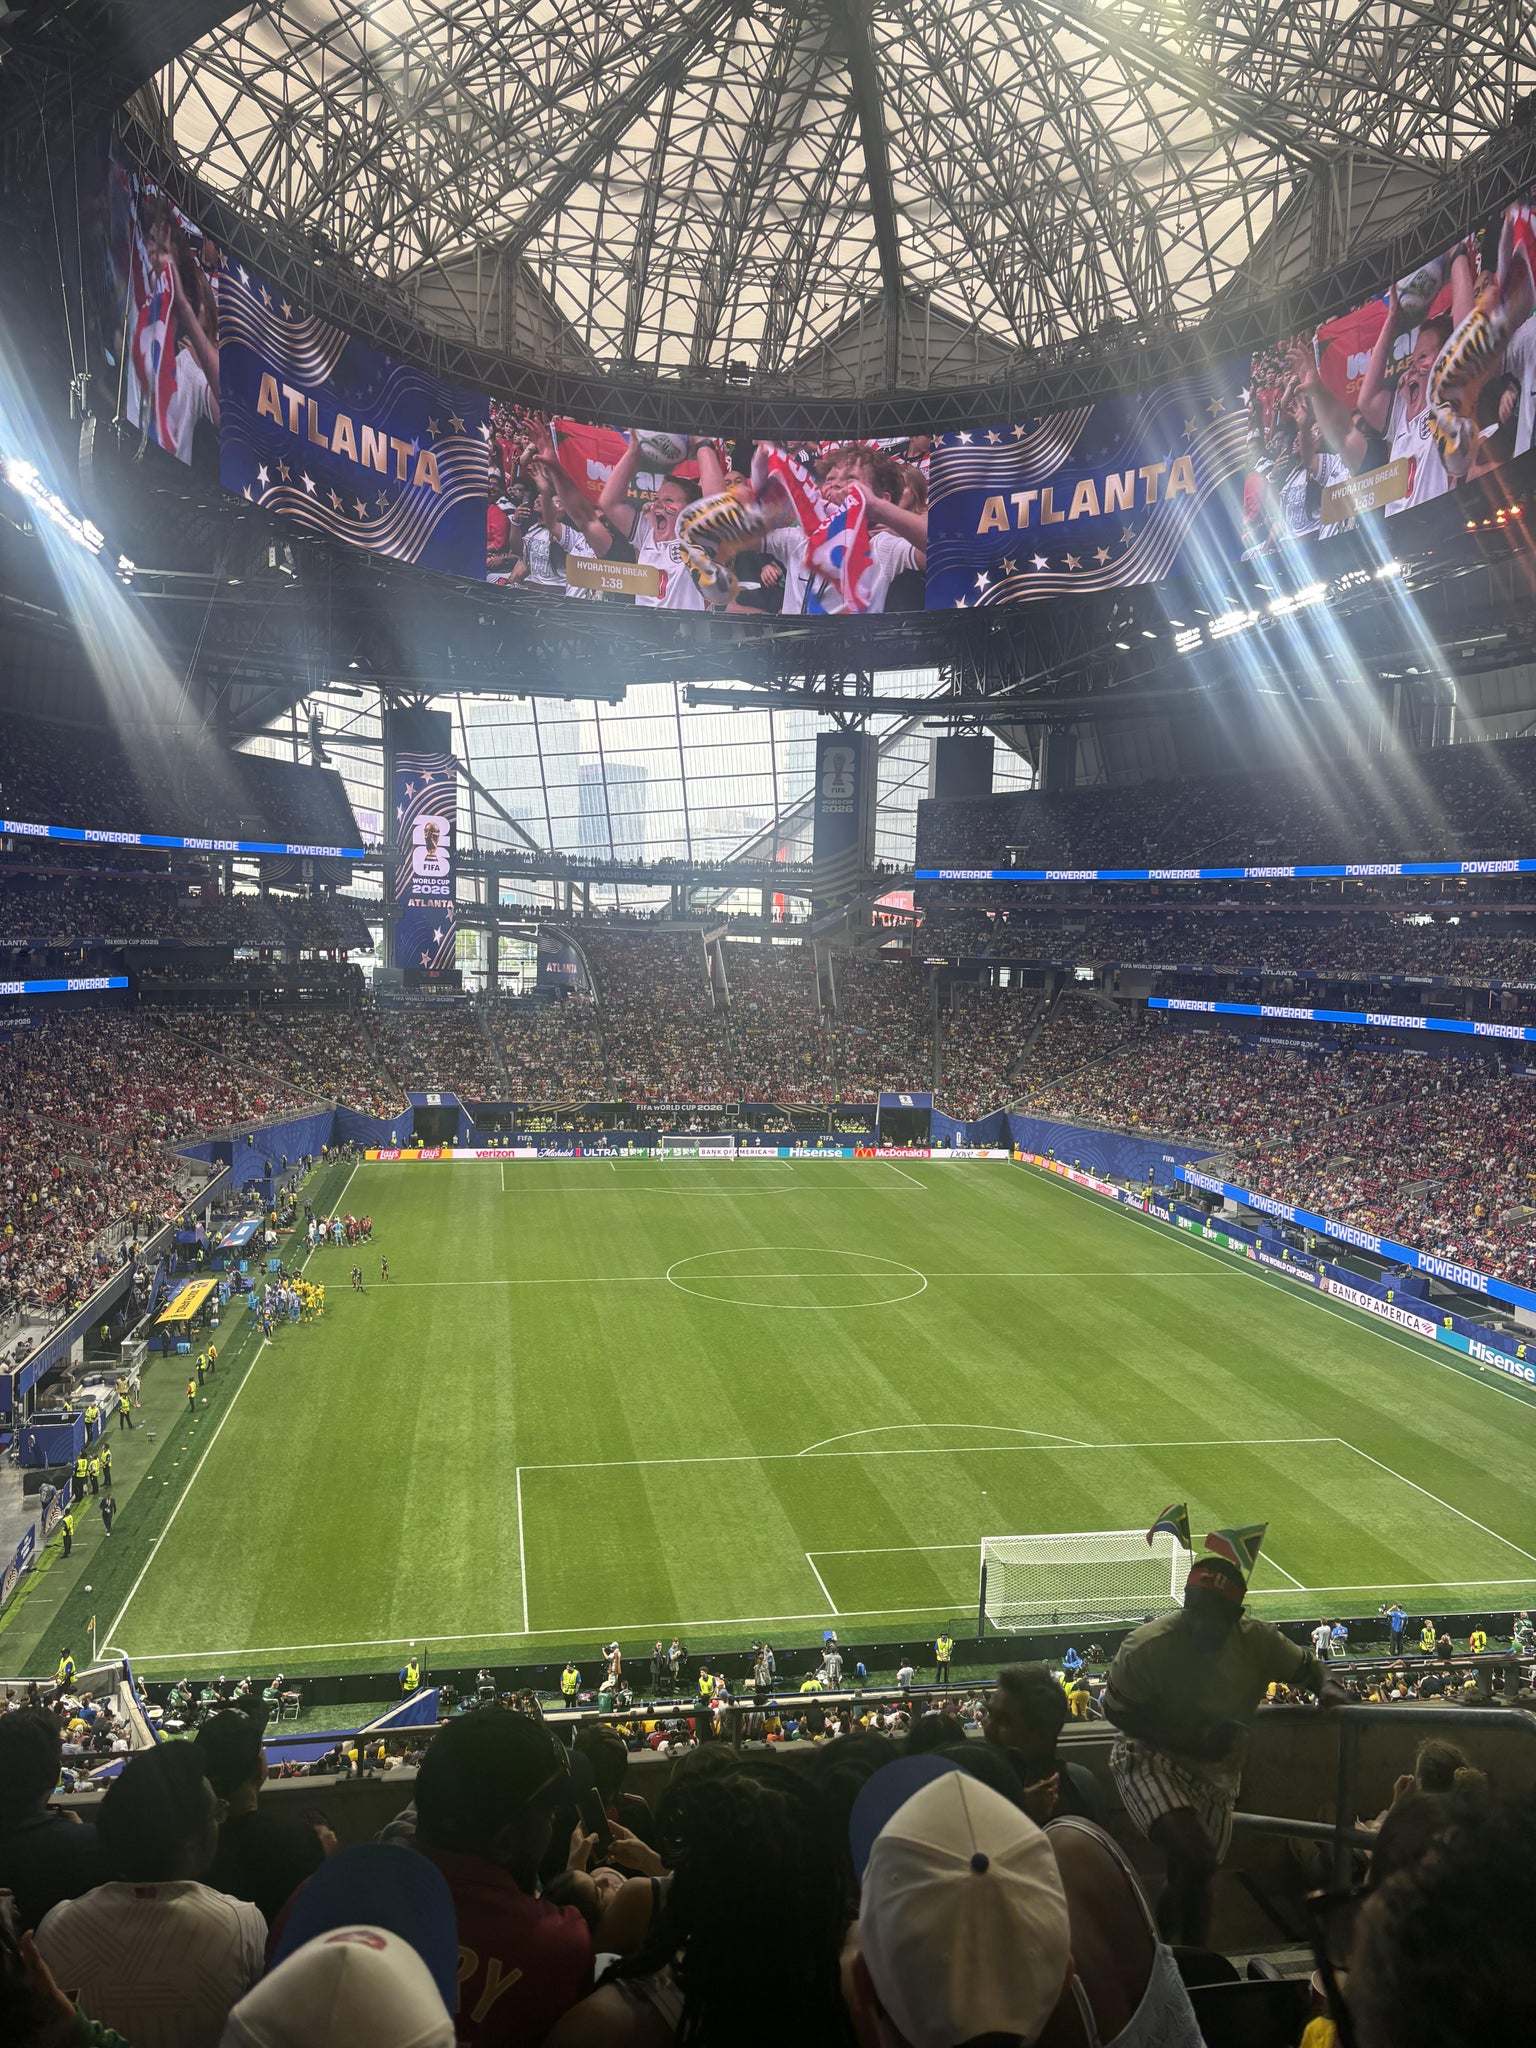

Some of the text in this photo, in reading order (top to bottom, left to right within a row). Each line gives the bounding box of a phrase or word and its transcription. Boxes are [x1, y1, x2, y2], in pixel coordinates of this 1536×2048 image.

[256, 371, 442, 494] ATLANTA
[1331, 466, 1399, 500] HYDRATION BREAK
[976, 454, 1197, 535] ATLANTA
[577, 561, 648, 577] HYDRATION BREAK
[601, 577, 623, 590] 1:38
[821, 805, 854, 813] 2026
[3, 821, 50, 837] POWERADE
[84, 830, 141, 844] POWERADE
[183, 838, 239, 851] POWERADE
[286, 844, 343, 857] POWERADE
[1244, 867, 1295, 878] POWERADE
[1345, 864, 1402, 876] POWERADE
[1460, 860, 1520, 873] POWERADE
[577, 869, 684, 881] FIFA WORLD CUP 2026
[939, 870, 993, 879] POWERADE
[1045, 870, 1098, 880] POWERADE
[1148, 869, 1200, 879] POWERADE
[412, 885, 450, 895] 2026
[407, 898, 454, 908] ATLANTA
[67, 978, 110, 990] POWERADE
[1501, 981, 1536, 990] ATLANTA
[1261, 1006, 1314, 1019] POWERADE
[1366, 1013, 1427, 1029] POWERADE
[1473, 1022, 1526, 1040] POWERADE
[475, 1149, 515, 1158] verizon
[537, 1148, 574, 1157] Michelob
[583, 1148, 619, 1157] ULTRA
[789, 1148, 843, 1157] Hisense
[875, 1148, 929, 1158] McDonald's
[950, 1150, 974, 1159] Dove
[1162, 1155, 1175, 1163] FIFA
[1184, 1171, 1224, 1195] POWERADE
[1148, 1203, 1170, 1221] ULTRA
[1248, 1192, 1295, 1222] POWERADE
[1325, 1220, 1381, 1254] POWERADE
[1259, 1252, 1315, 1283] FIFA WORLD CUP 2026
[1418, 1252, 1488, 1294] POWERADE
[1331, 1281, 1421, 1331] BANK OF AMERICA
[1469, 1338, 1535, 1384] Hisense
